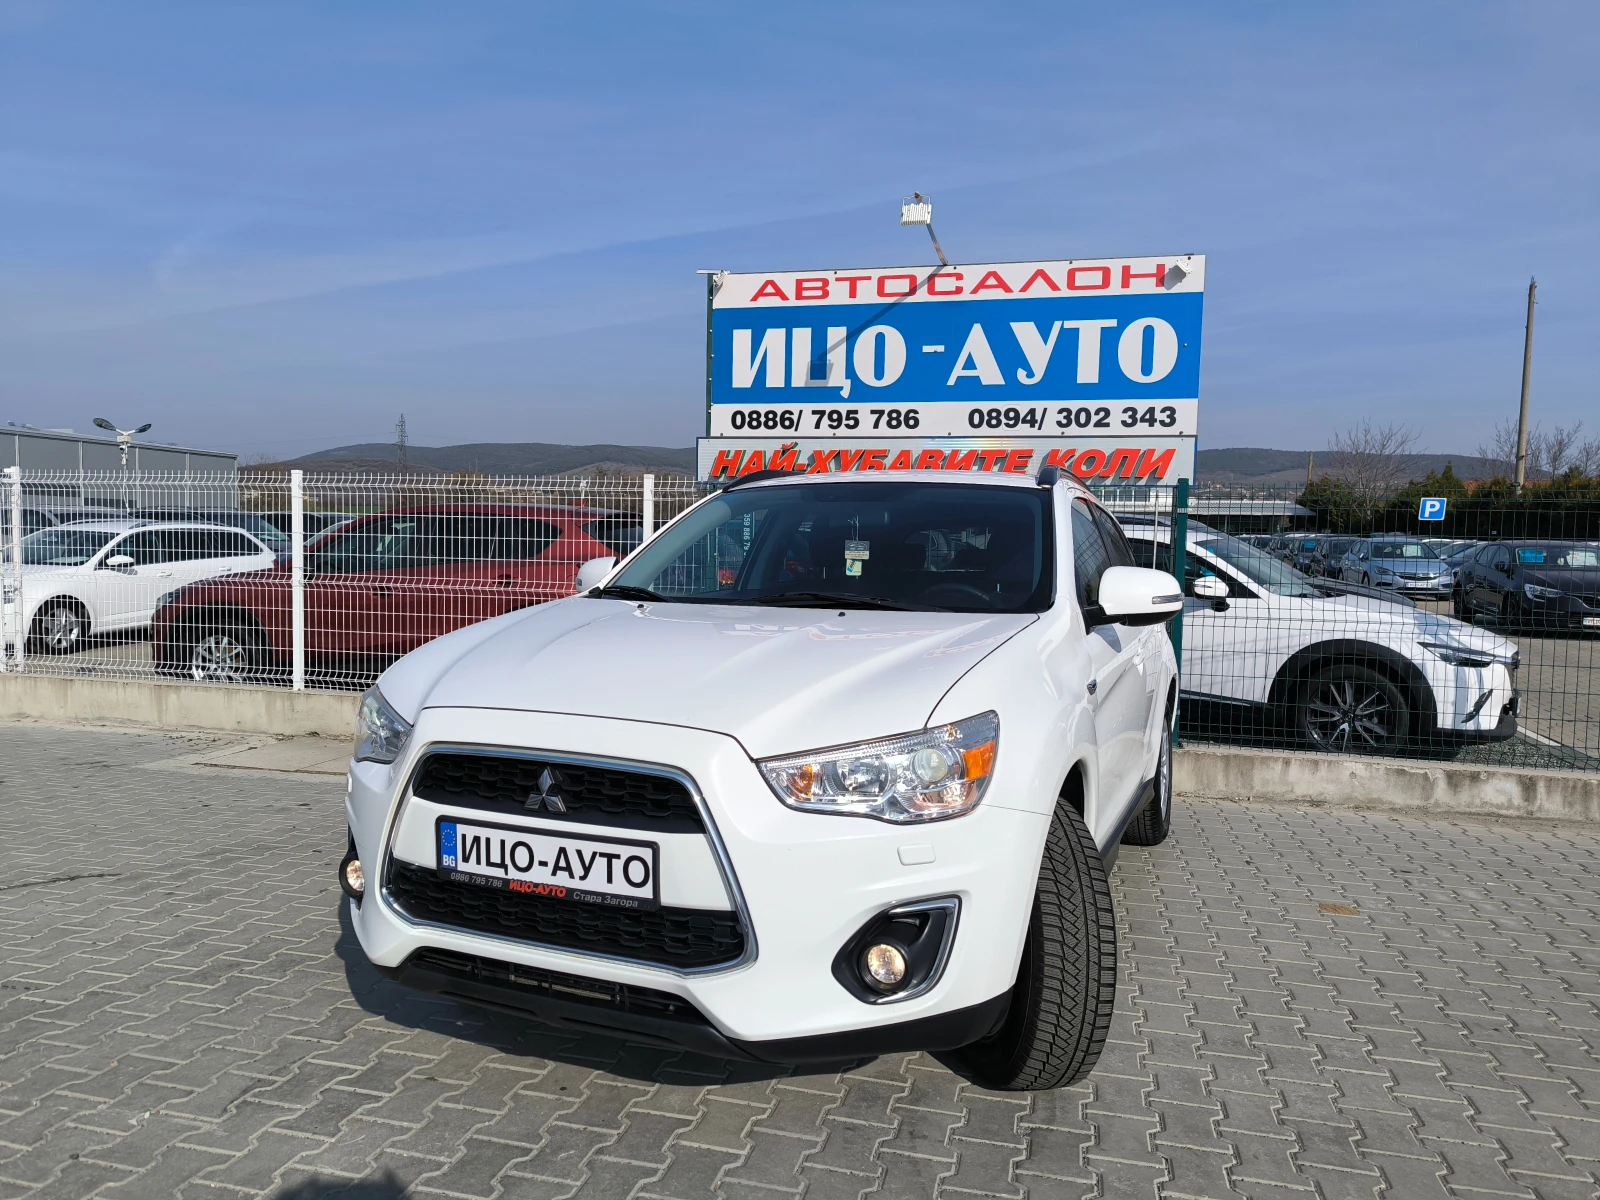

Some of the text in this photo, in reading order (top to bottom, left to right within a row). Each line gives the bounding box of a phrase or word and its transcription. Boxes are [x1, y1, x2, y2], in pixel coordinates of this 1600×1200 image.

[750, 263, 1166, 302] АВТОСАЛОН
[730, 408, 920, 432] 0886/ 795 786
[967, 405, 1177, 431] 0894/ 302 343
[1424, 501, 1441, 518] P
[442, 855, 456, 868] BG
[461, 833, 650, 888] ИЦО-АУТО
[471, 875, 486, 885] 795
[488, 878, 503, 888] 786
[509, 879, 567, 898] ИЦО-АУТО
[573, 891, 638, 908] Стара Загора
